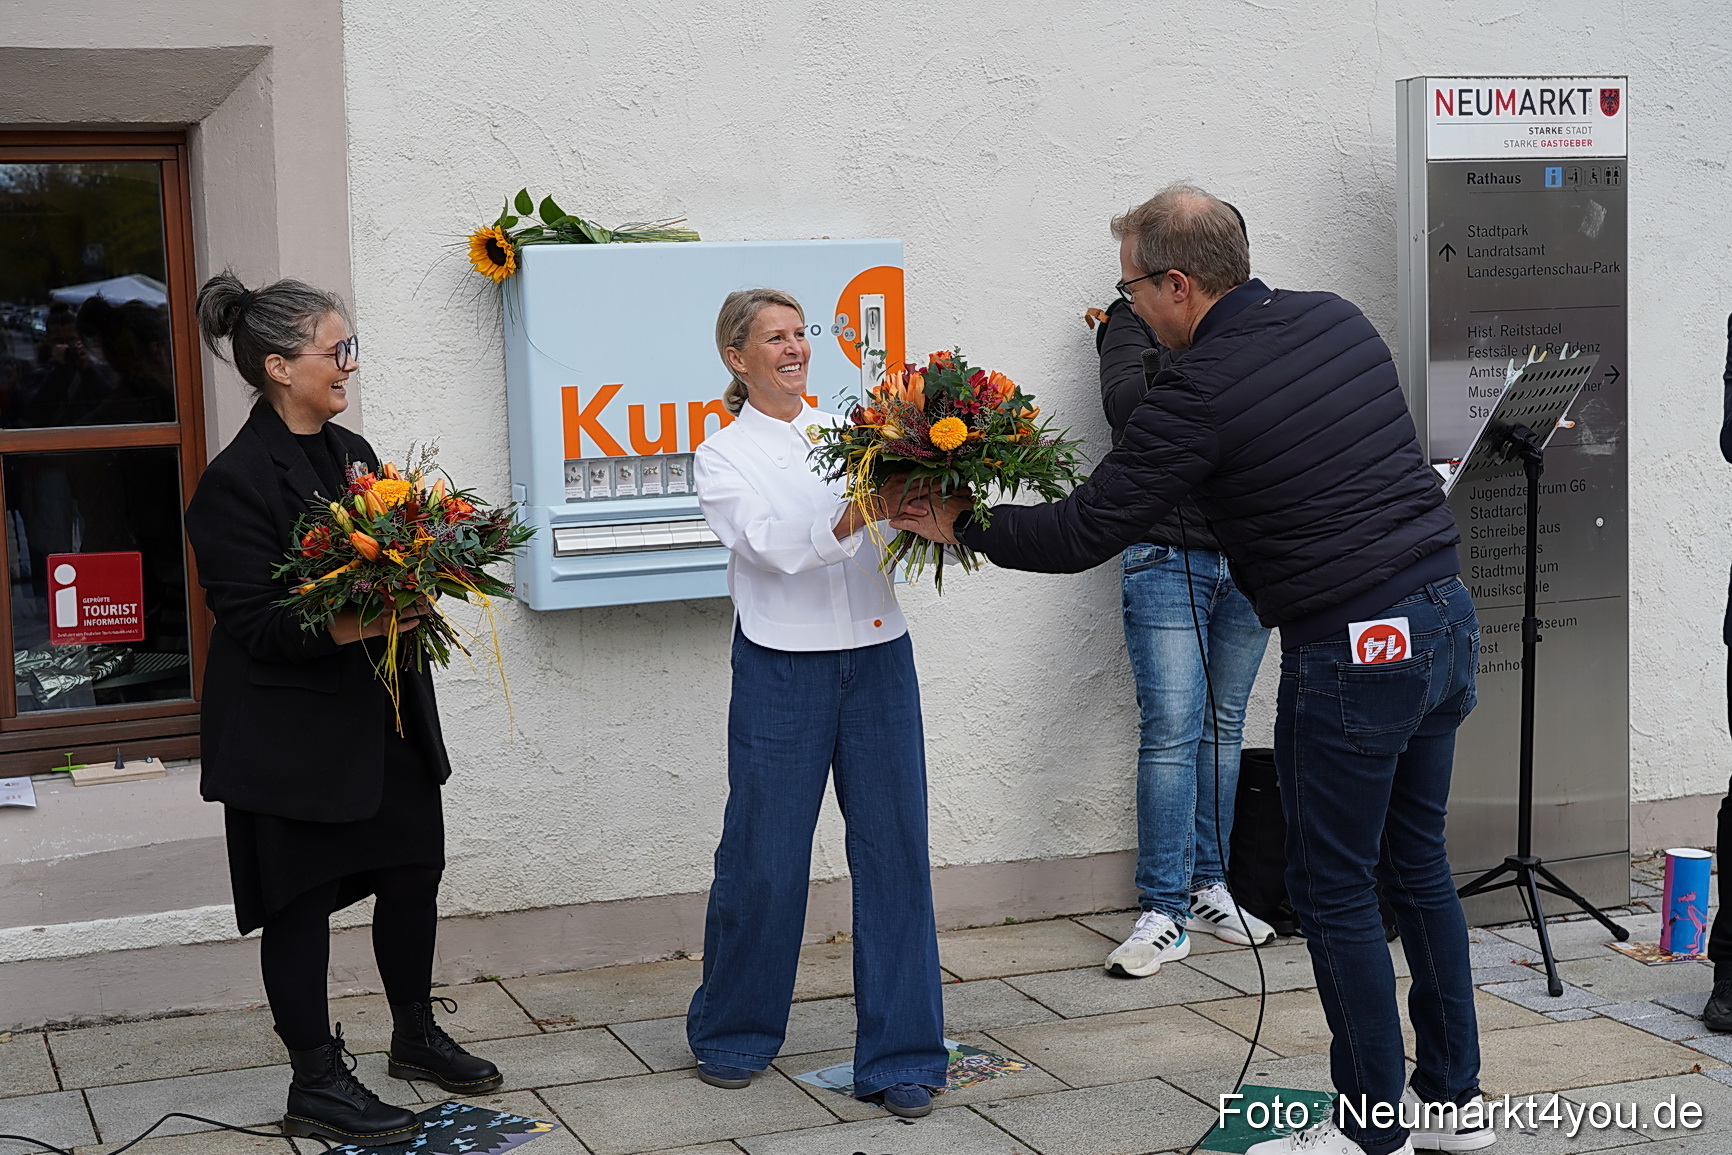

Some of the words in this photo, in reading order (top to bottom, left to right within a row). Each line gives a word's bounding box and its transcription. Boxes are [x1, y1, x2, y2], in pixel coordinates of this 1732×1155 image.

[1435, 88, 1592, 116] NEUMARKT
[1528, 126, 1563, 135] STARKE
[1565, 126, 1593, 135] STADT
[1503, 139, 1538, 148] STARKE
[1540, 139, 1593, 148] GASTGEBER
[1467, 172, 1522, 185] Rathaus
[1467, 224, 1529, 239] Stadtpark
[1467, 243, 1546, 258] Landratsamt
[1467, 260, 1621, 279] Landesgartenschau-Park
[1467, 325, 1496, 338] Hist.
[1500, 322, 1562, 337] Reitstadel
[1467, 344, 1518, 358] Festsäle
[1521, 344, 1542, 356] dr
[1545, 341, 1601, 354] Reidenz
[1469, 482, 1567, 501] Jugendzetrum
[1569, 479, 1587, 493] G6
[1470, 522, 1561, 540] Schreibeaus
[1470, 543, 1544, 560] Bürgerhas
[82, 596, 111, 604] GEPRÜFTE
[83, 603, 138, 617] TOURIST
[83, 617, 138, 627] INFORMATION
